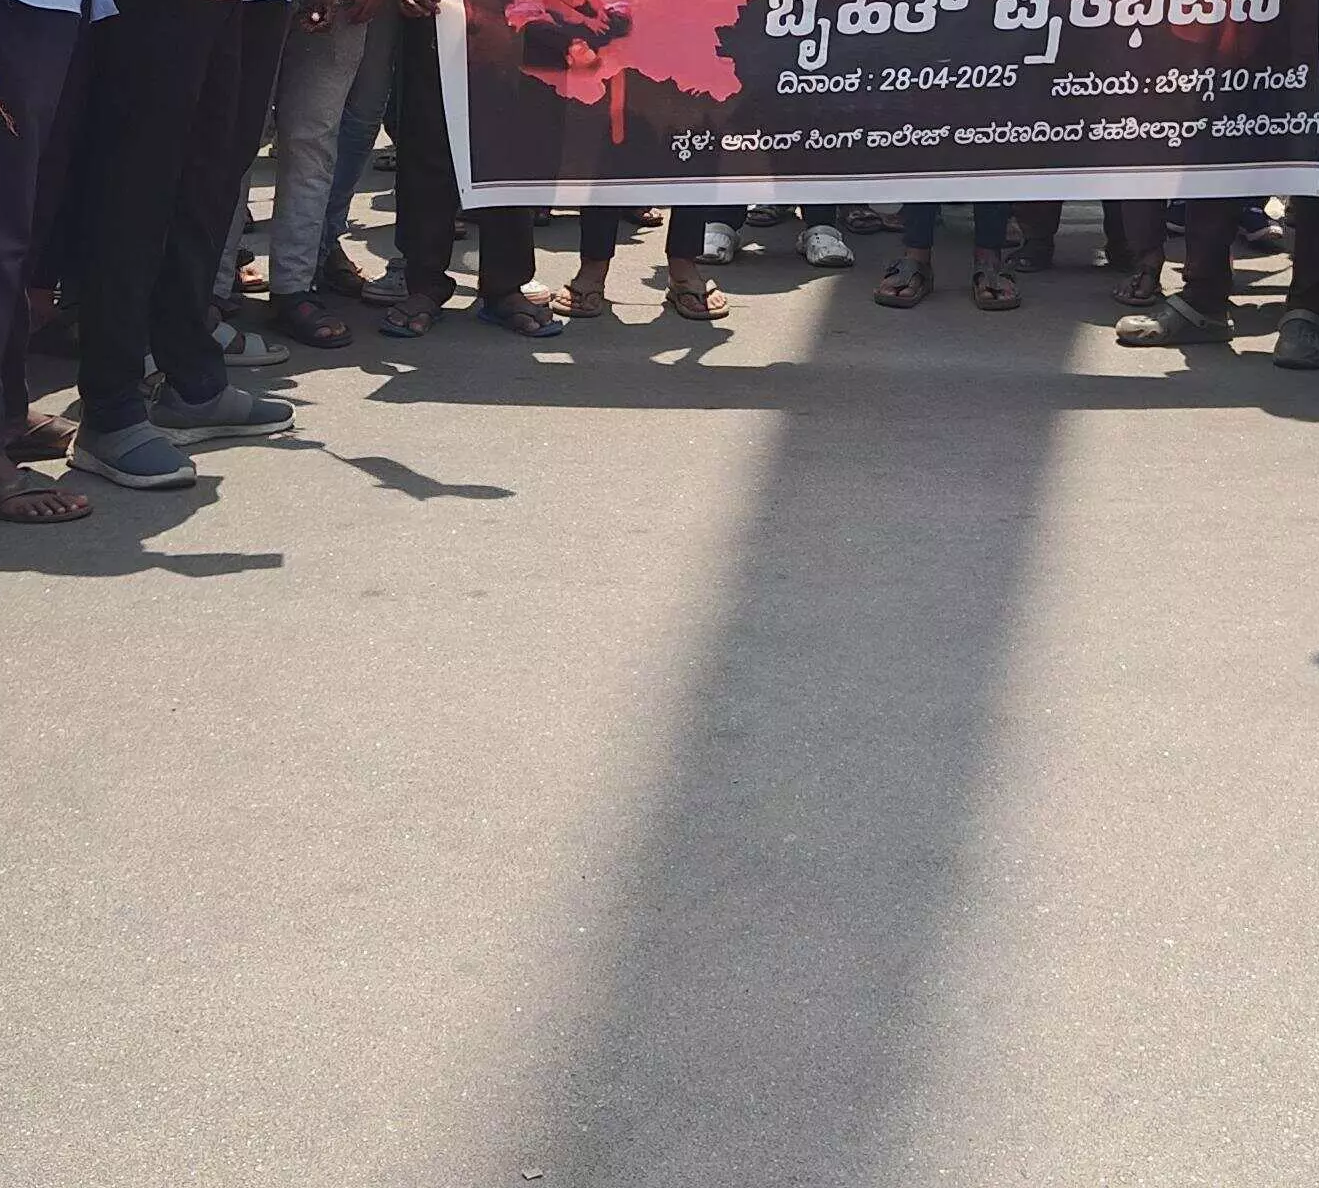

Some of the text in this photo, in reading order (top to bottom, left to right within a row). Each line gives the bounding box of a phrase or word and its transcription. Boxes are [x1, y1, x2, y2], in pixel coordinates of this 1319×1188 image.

[777, 69, 863, 95] ದಿನಾಂಕ
[879, 64, 1018, 92] 28-04-2025
[1051, 71, 1139, 97] ಸಮಯ
[1155, 65, 1217, 101] ಬೆಳಗ್ಗೆ
[1219, 69, 1249, 92] 10
[1253, 64, 1309, 90] ಗಂಟೆ
[721, 129, 801, 152] ಆನಂದ್
[805, 127, 864, 150] ಸಿಂಗ್
[866, 124, 950, 149] ಕಾಲೇಜ್
[954, 118, 1084, 146] ಆವರಣದಿಂದ
[1088, 115, 1209, 148] ತಹಶೀಲ್ದಾರ್
